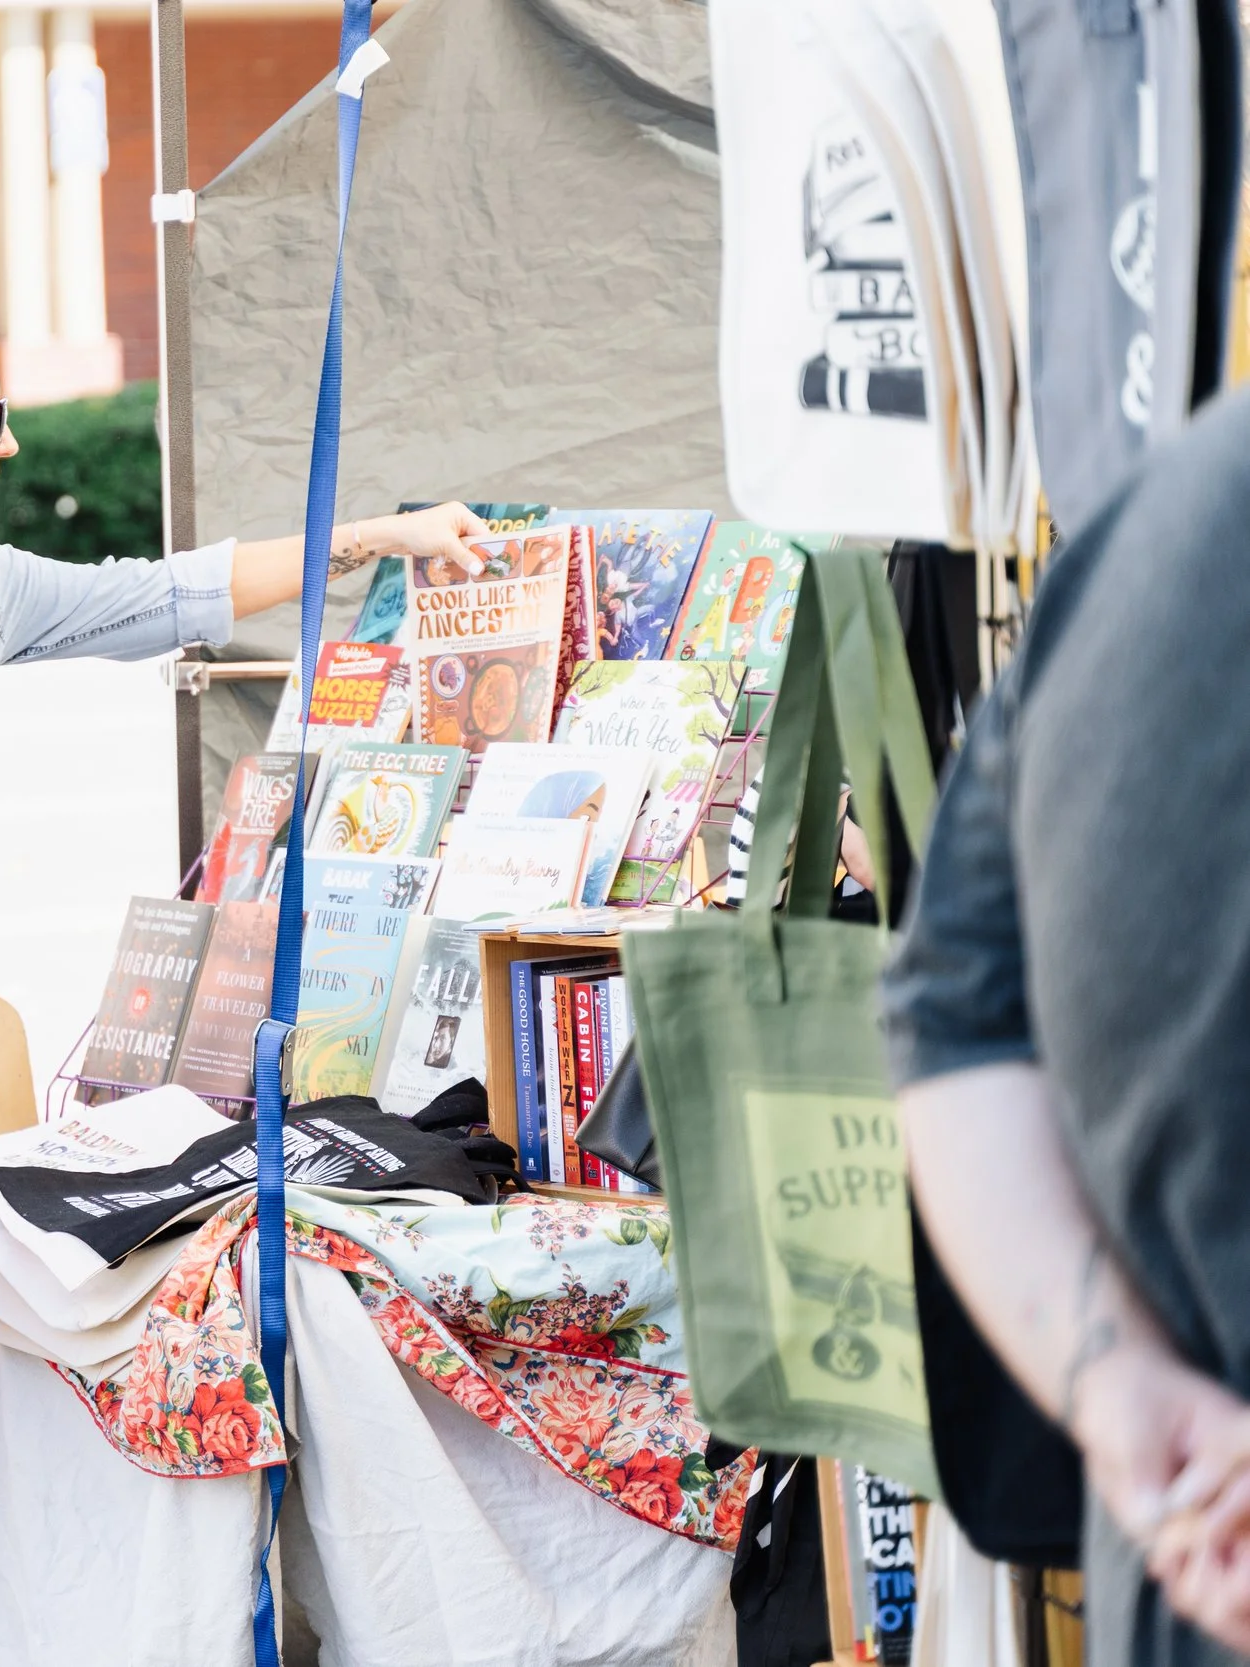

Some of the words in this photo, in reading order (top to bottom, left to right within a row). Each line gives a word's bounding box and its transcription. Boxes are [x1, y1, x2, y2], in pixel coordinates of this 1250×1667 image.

[598, 520, 640, 547] ARE
[645, 527, 683, 569] THE
[760, 531, 781, 549] An
[416, 588, 471, 613] COOK
[477, 585, 517, 607] LIKE
[313, 677, 385, 703] HORSE
[310, 701, 376, 721] PUZZLES
[585, 713, 640, 748] With
[646, 717, 685, 754] You
[343, 750, 371, 770] THE
[375, 752, 405, 771] EGG
[409, 753, 449, 773] TREE
[243, 767, 296, 804] WINGS
[237, 799, 281, 828] FIRE
[525, 857, 560, 887] Bunny
[313, 909, 359, 934] THERE
[372, 916, 402, 938] ARE
[111, 951, 199, 983] BIOGRAPHY
[243, 948, 252, 962] A
[216, 970, 265, 991] FLOWER
[300, 968, 348, 992] RIVERS
[370, 976, 388, 997] IN
[134, 995, 147, 1010] OF
[201, 995, 267, 1019] TRAVELED
[518, 989, 528, 1029] GOOD
[558, 984, 569, 1042] WORLD
[599, 987, 609, 1034] DIVINE
[188, 1020, 201, 1035] IN
[204, 1023, 220, 1039] MY
[577, 991, 591, 1063] CABIN
[88, 1025, 176, 1060] RESISTANCE
[343, 1034, 375, 1057] SKY
[521, 1032, 531, 1078] HOUSE
[562, 1047, 571, 1081] WAR
[602, 1039, 611, 1082] MIGH
[524, 1083, 532, 1128] Tananarive
[562, 1085, 575, 1108] Z
[831, 1113, 899, 1150] DO
